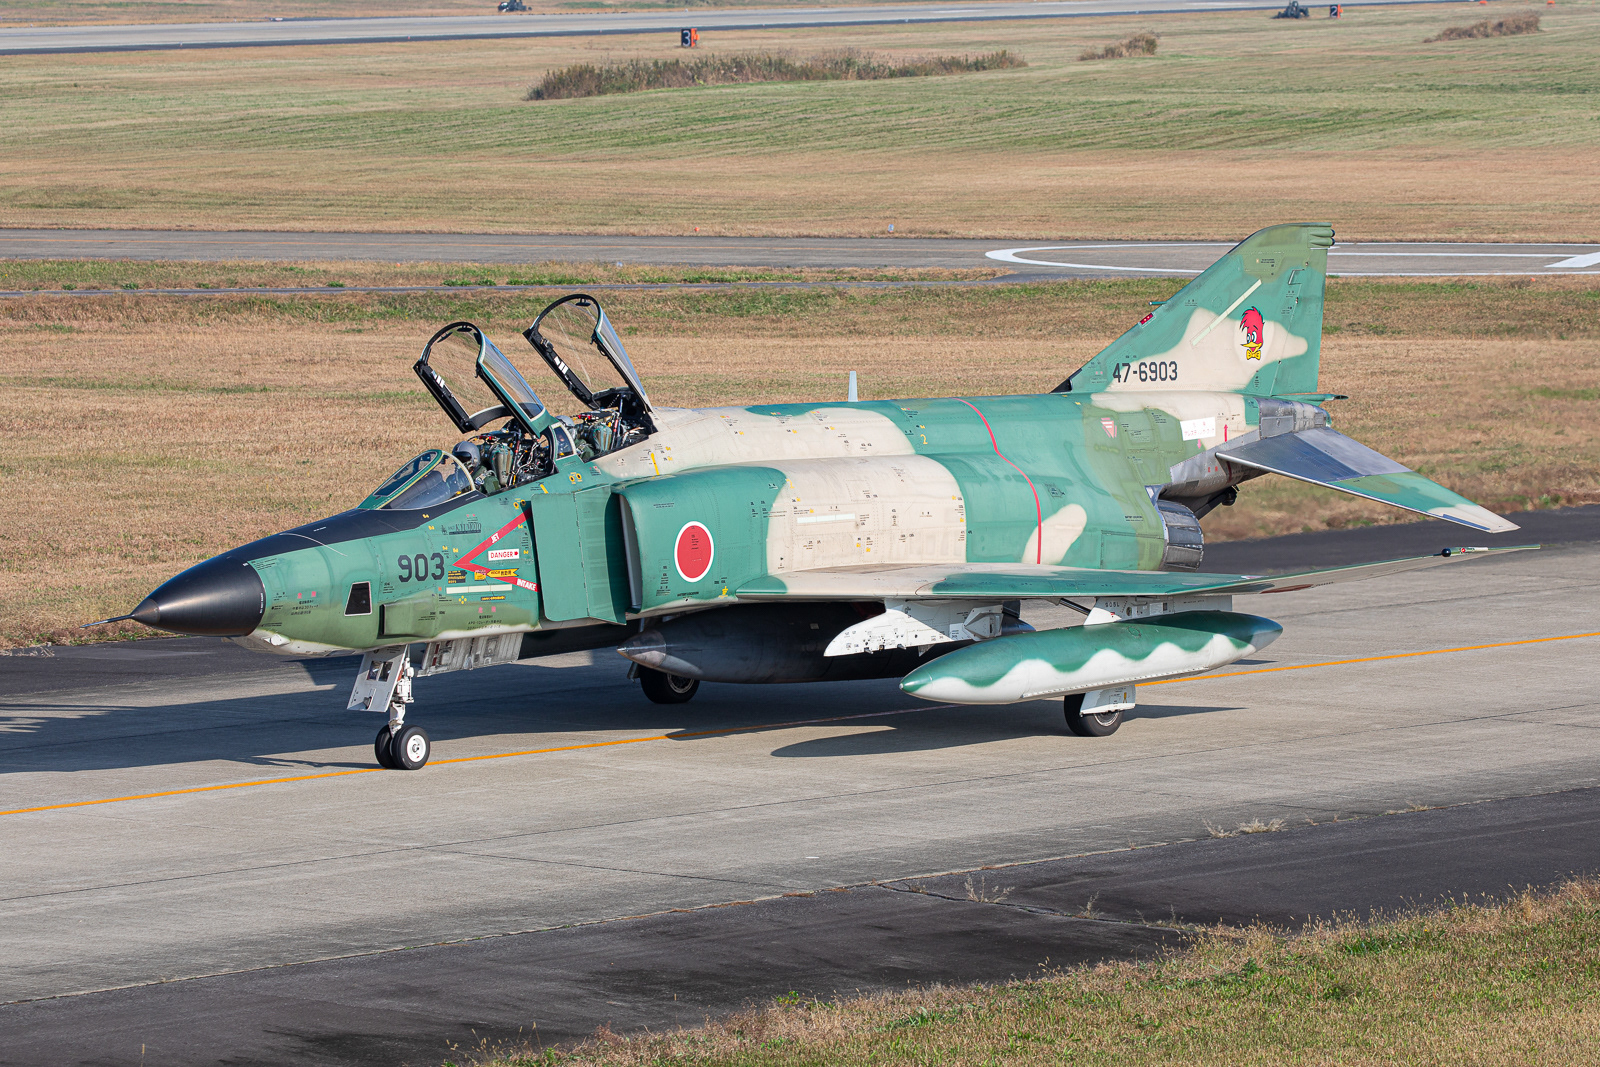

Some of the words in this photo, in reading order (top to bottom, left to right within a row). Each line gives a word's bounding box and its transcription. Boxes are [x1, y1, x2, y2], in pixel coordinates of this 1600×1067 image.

[1331, 5, 1337, 17] 2
[683, 30, 691, 46] 3
[1112, 361, 1178, 383] 47-6903
[491, 532, 500, 544] JET
[491, 551, 513, 559] DANGER
[397, 552, 445, 583] 903
[517, 578, 536, 591] INTAKE
